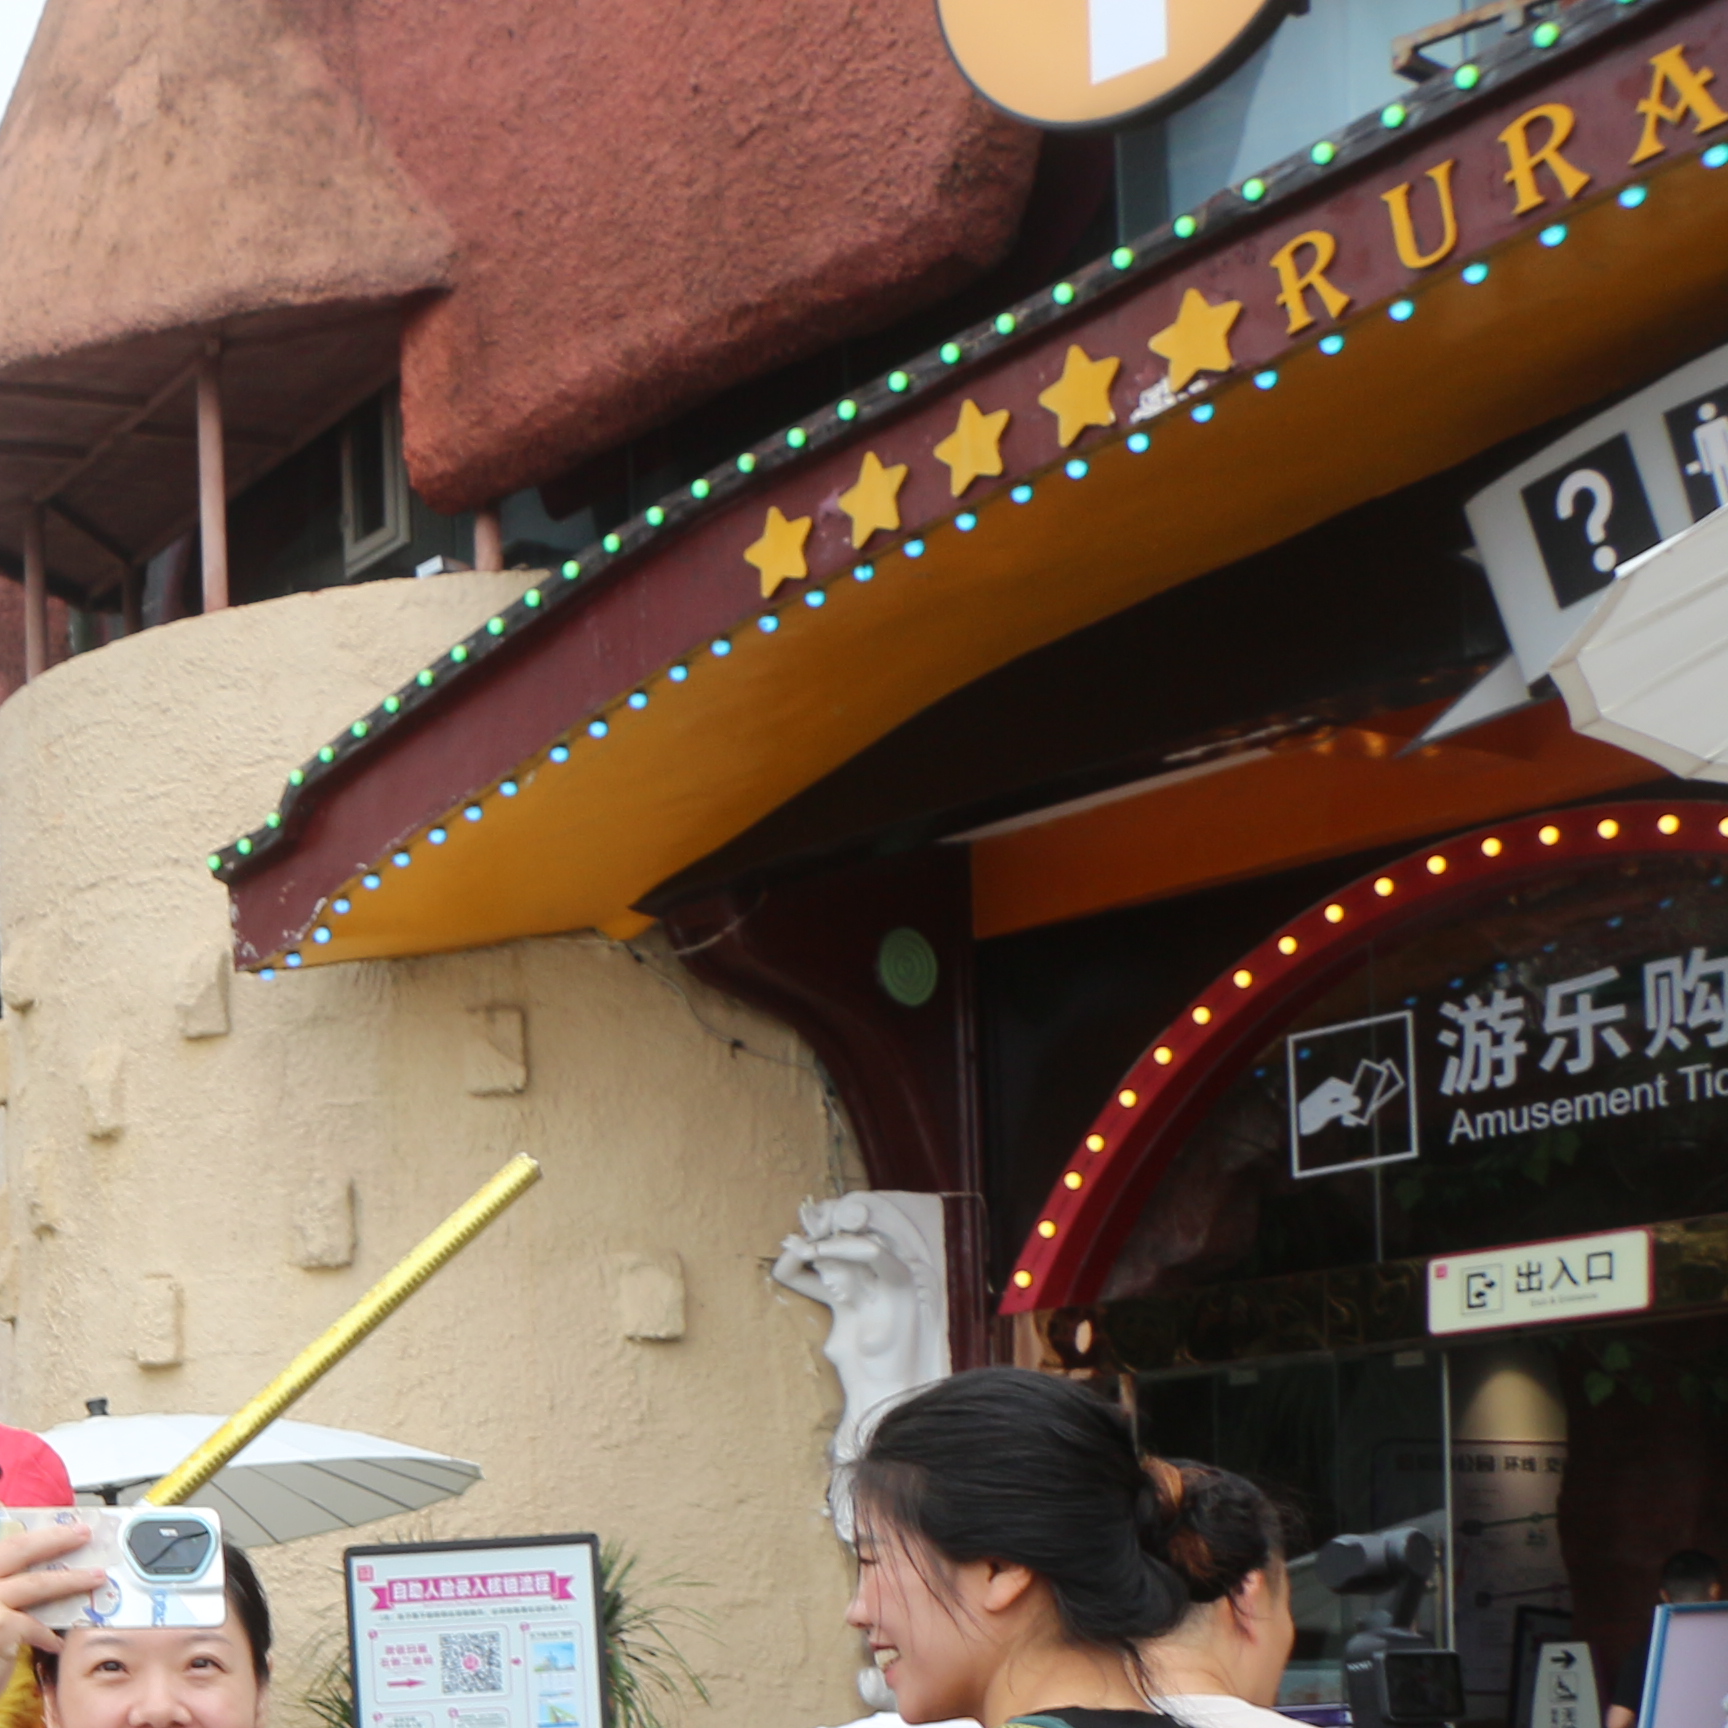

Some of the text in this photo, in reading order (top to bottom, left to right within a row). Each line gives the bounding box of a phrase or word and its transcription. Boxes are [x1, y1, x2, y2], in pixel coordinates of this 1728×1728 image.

[1438, 946, 1728, 1096] 游乐购
[1449, 1073, 1669, 1144] Amusement
[1515, 1250, 1613, 1293] 出入口
